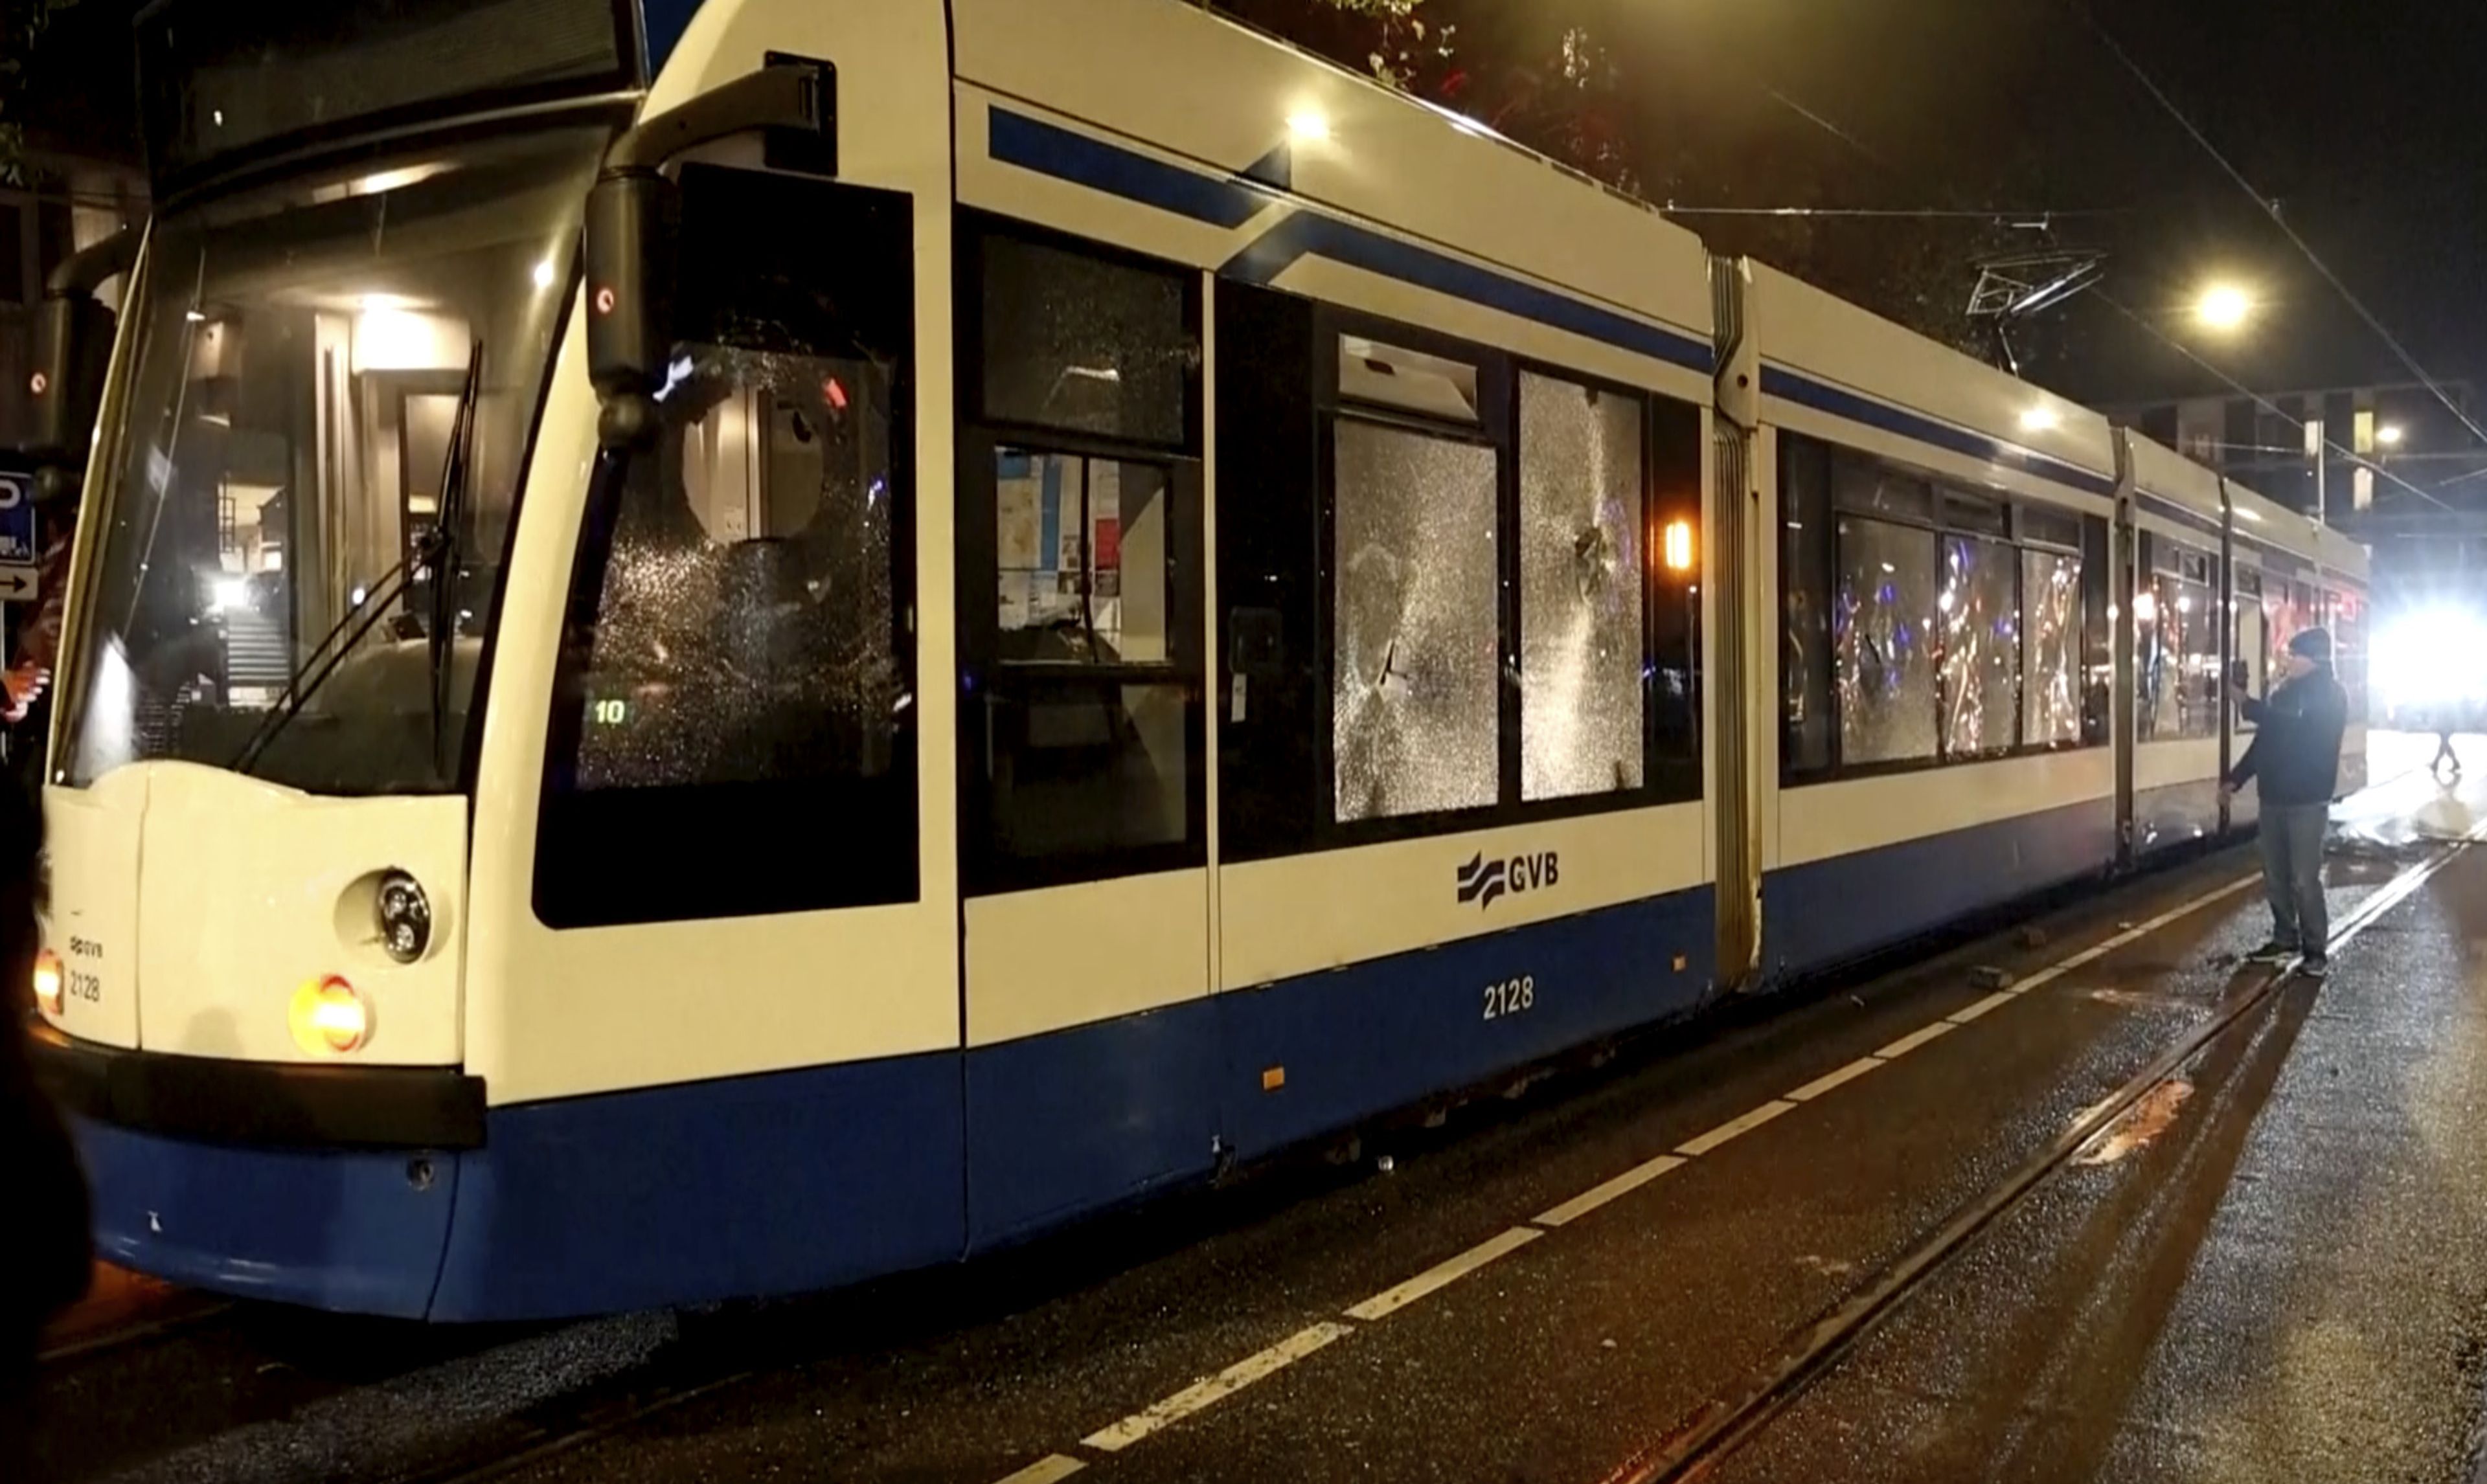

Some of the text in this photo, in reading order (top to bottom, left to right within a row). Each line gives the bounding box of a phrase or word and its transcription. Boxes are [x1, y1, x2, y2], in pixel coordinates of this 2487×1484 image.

[595, 700, 625, 723] 10
[1510, 852, 1558, 892] GVB
[71, 971, 100, 1002] 2128
[1483, 976, 1534, 1019] 2128
